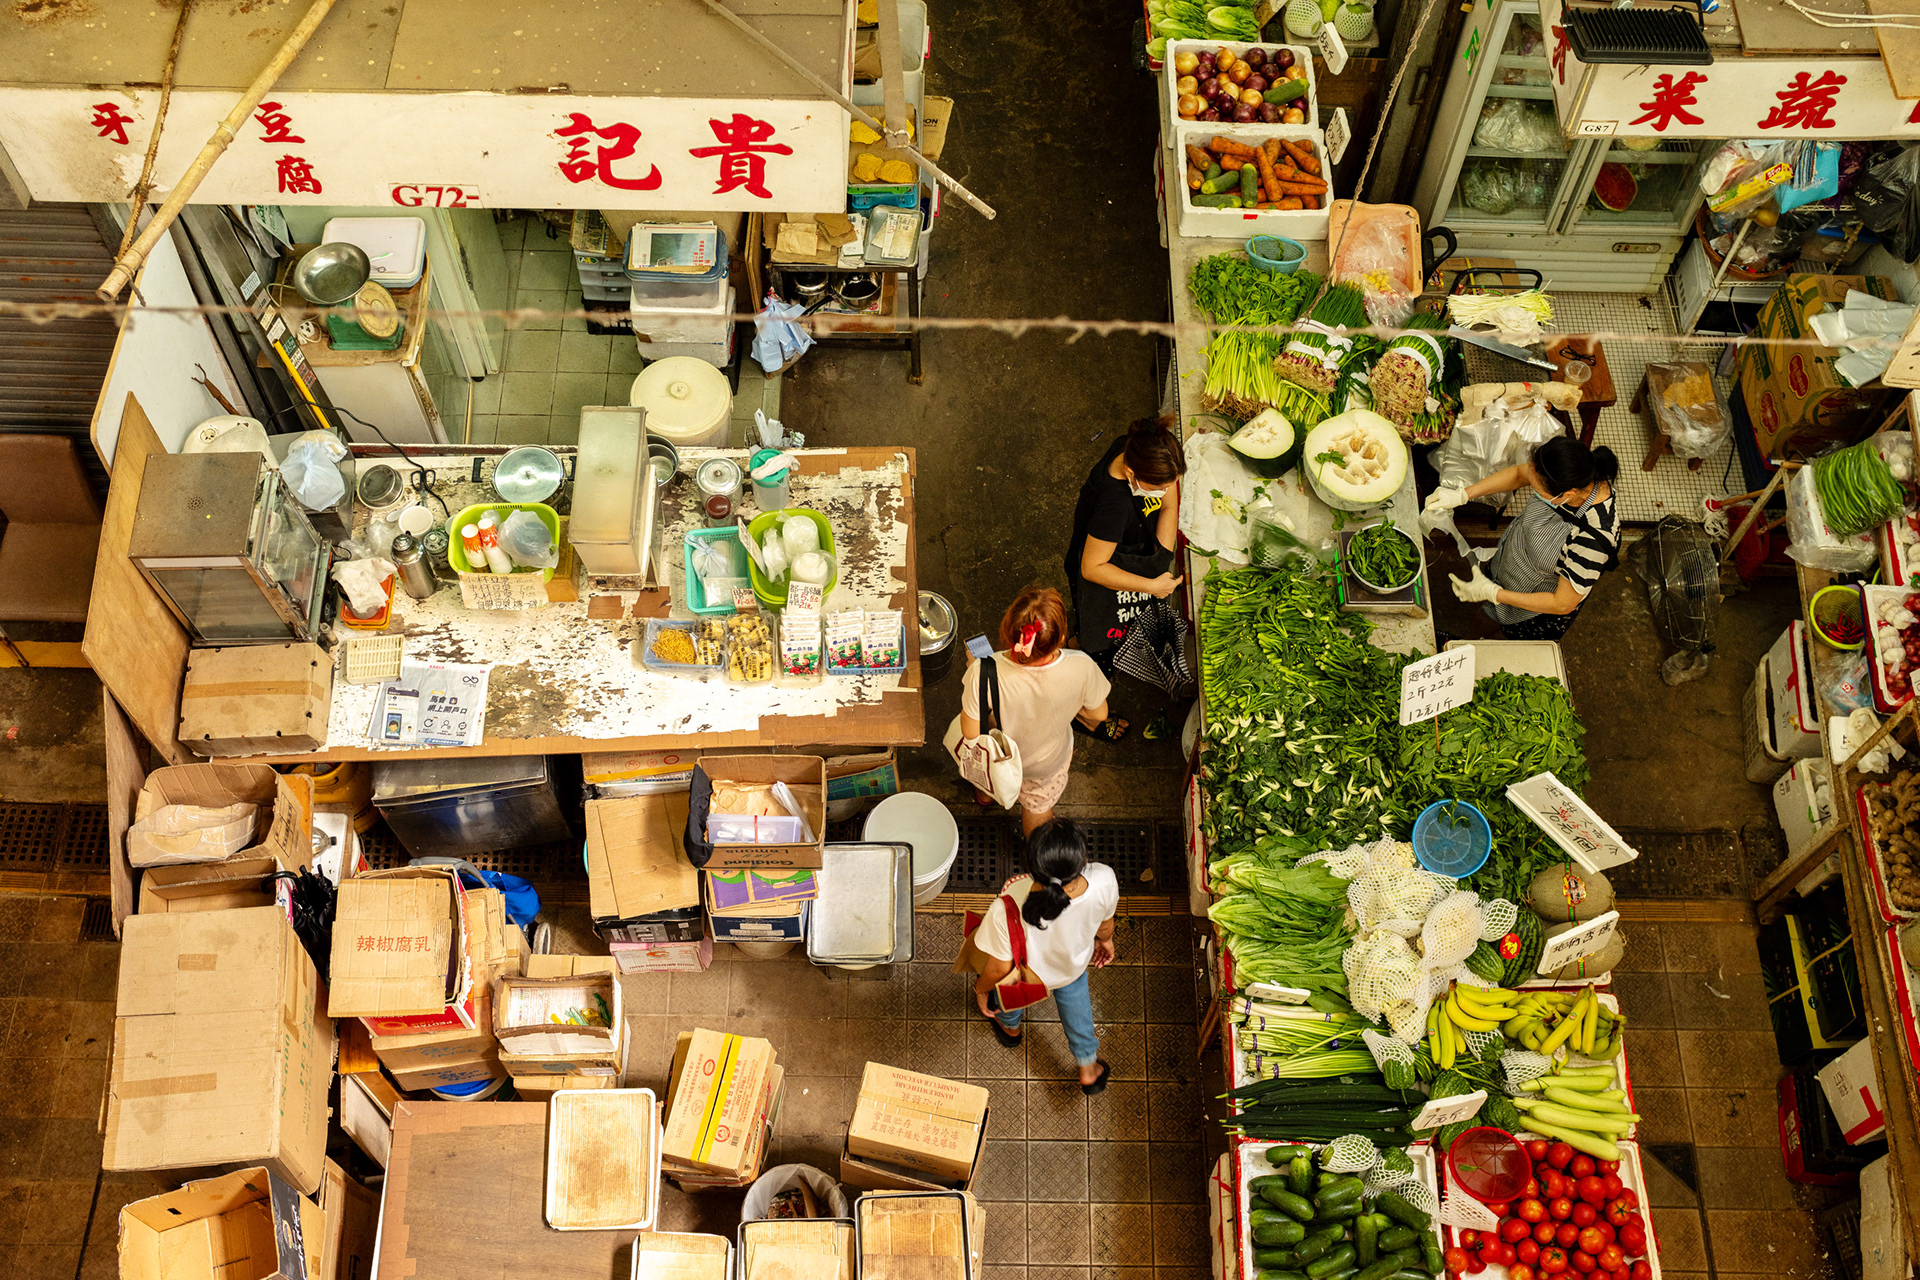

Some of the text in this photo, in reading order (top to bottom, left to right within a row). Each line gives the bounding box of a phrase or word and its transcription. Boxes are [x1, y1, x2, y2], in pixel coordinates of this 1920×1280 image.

[1584, 124, 1610, 133] G87
[356, 935, 431, 953] 辣椒腐乳
[895, 1081, 954, 1100] HANDLE WITH CARE
[902, 1091, 943, 1109] 小心轻放
